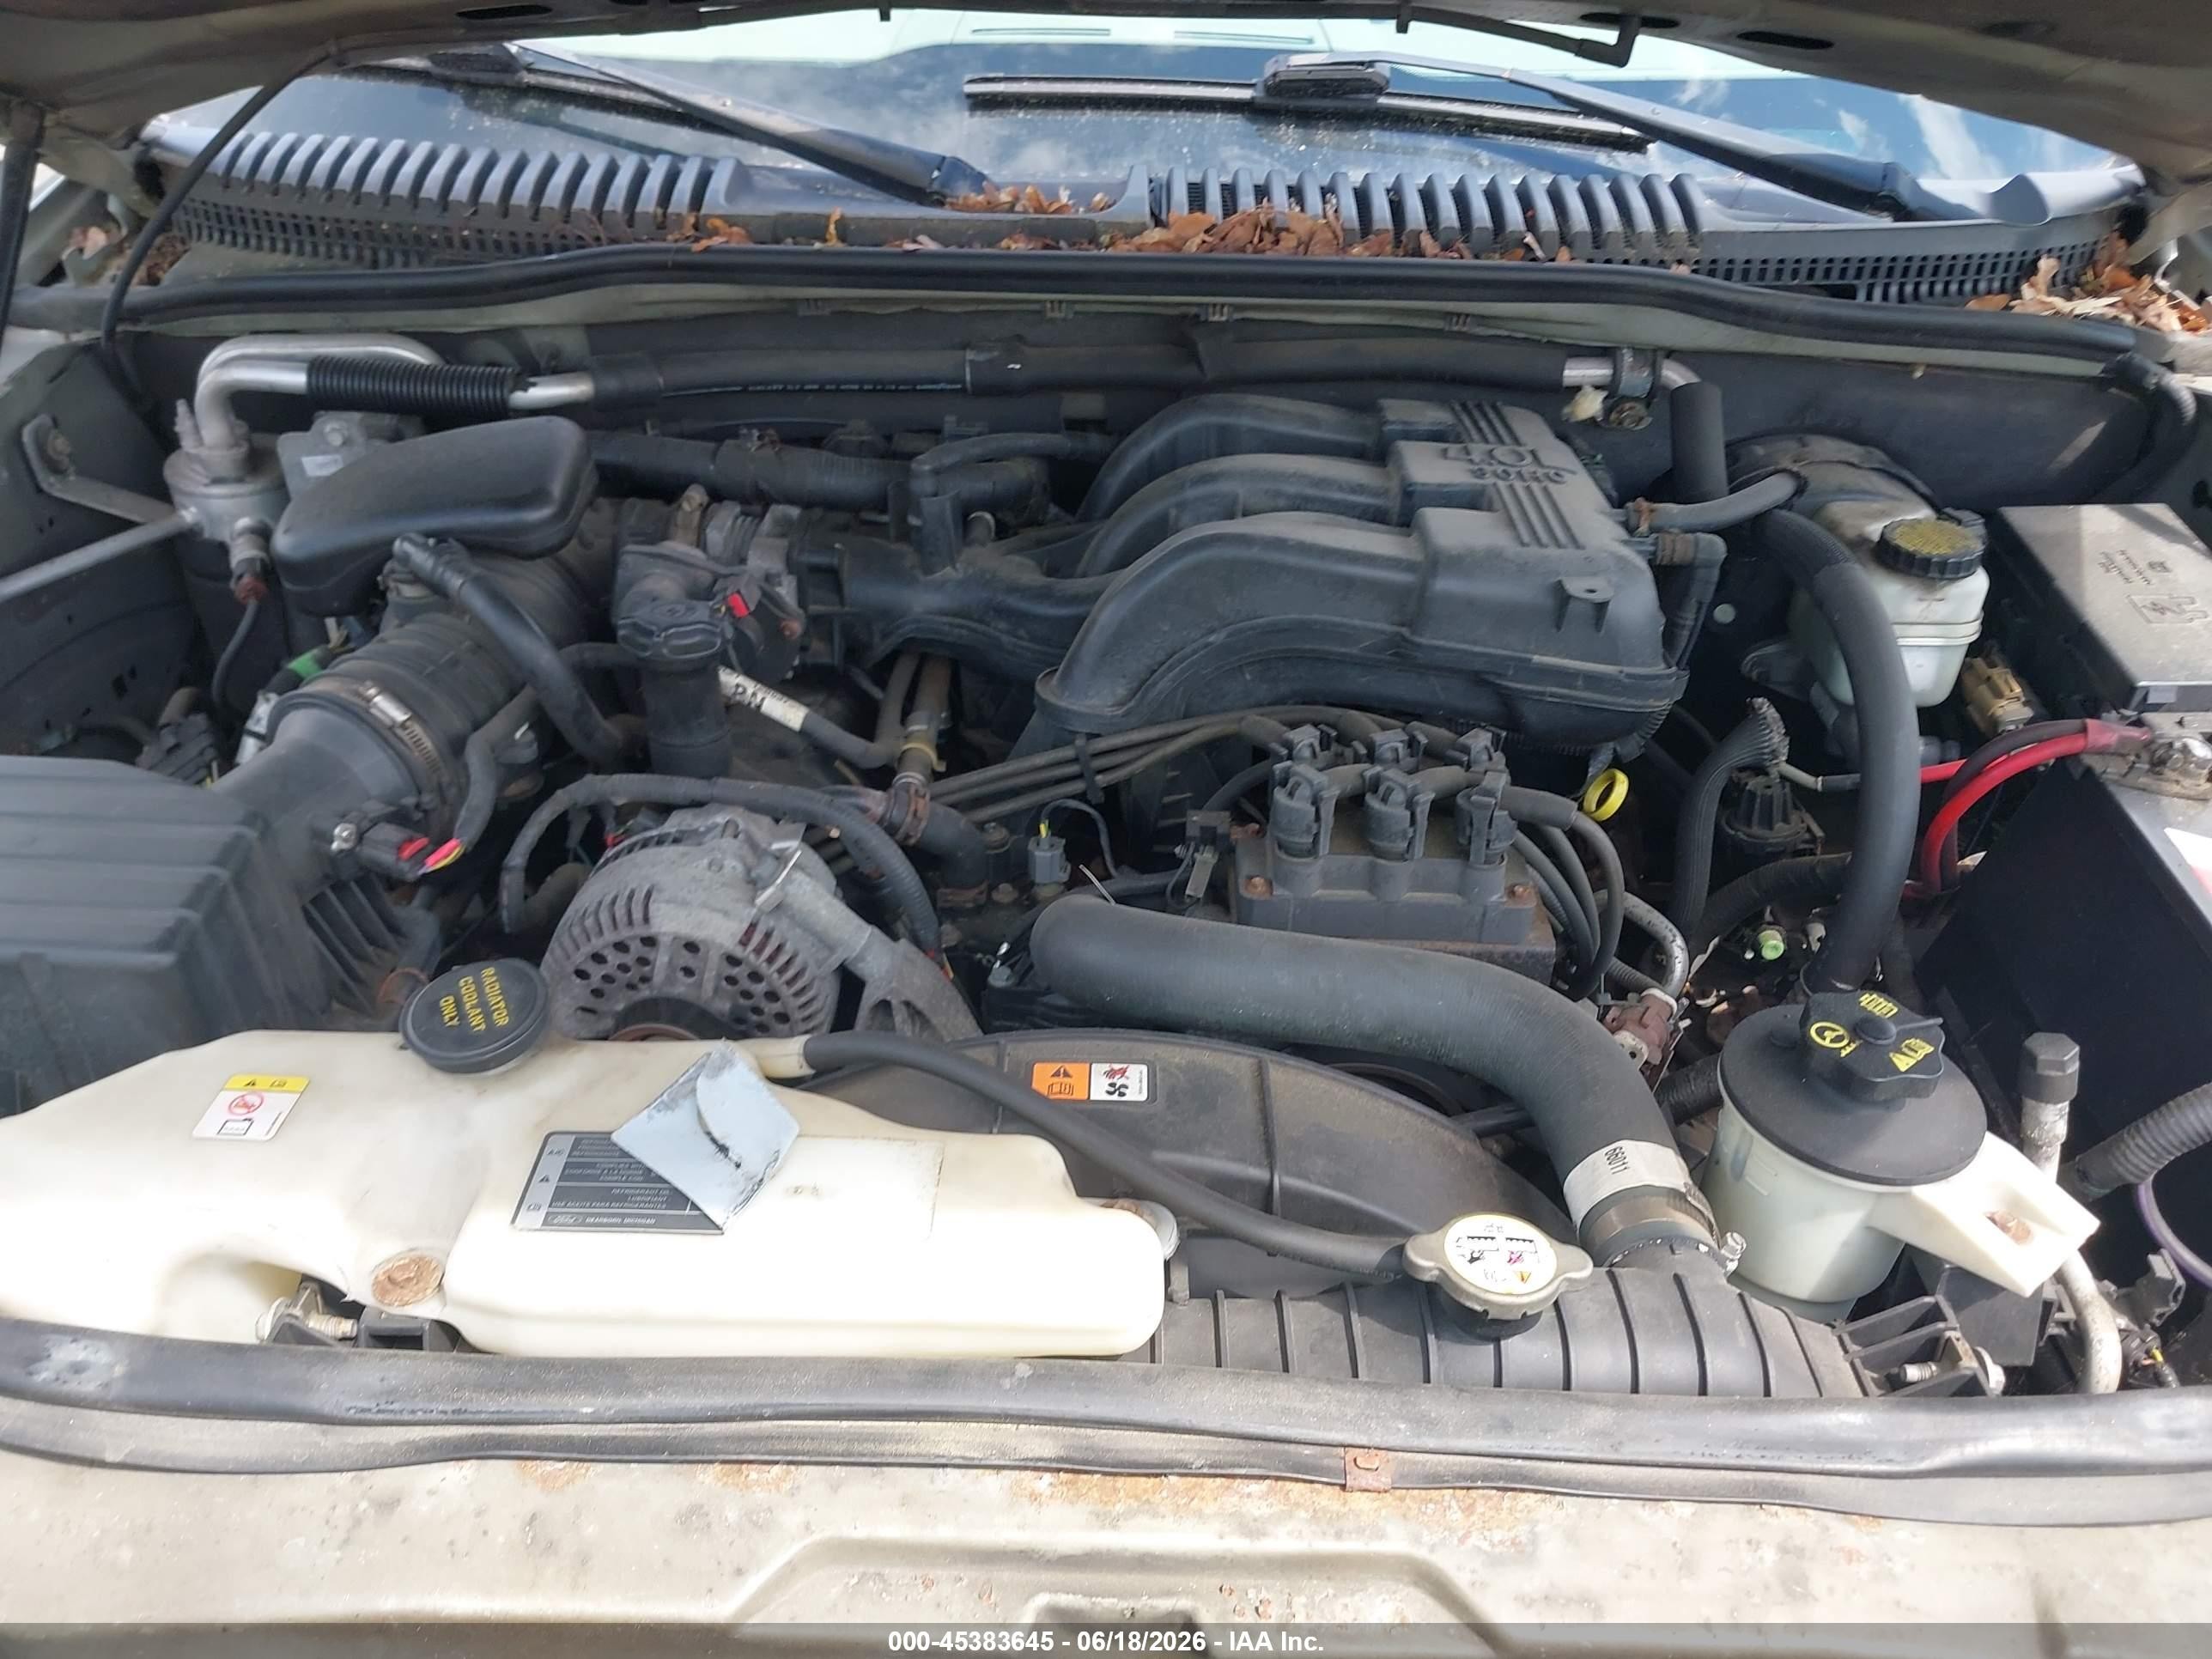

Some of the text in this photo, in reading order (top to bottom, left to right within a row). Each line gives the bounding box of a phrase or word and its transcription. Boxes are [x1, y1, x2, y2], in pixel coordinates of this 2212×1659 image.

[439, 995, 460, 1027] ONLY
[459, 975, 487, 1031] COOLANT
[481, 967, 509, 1027] RADIATOR
[1605, 1146, 1630, 1175] 66011
